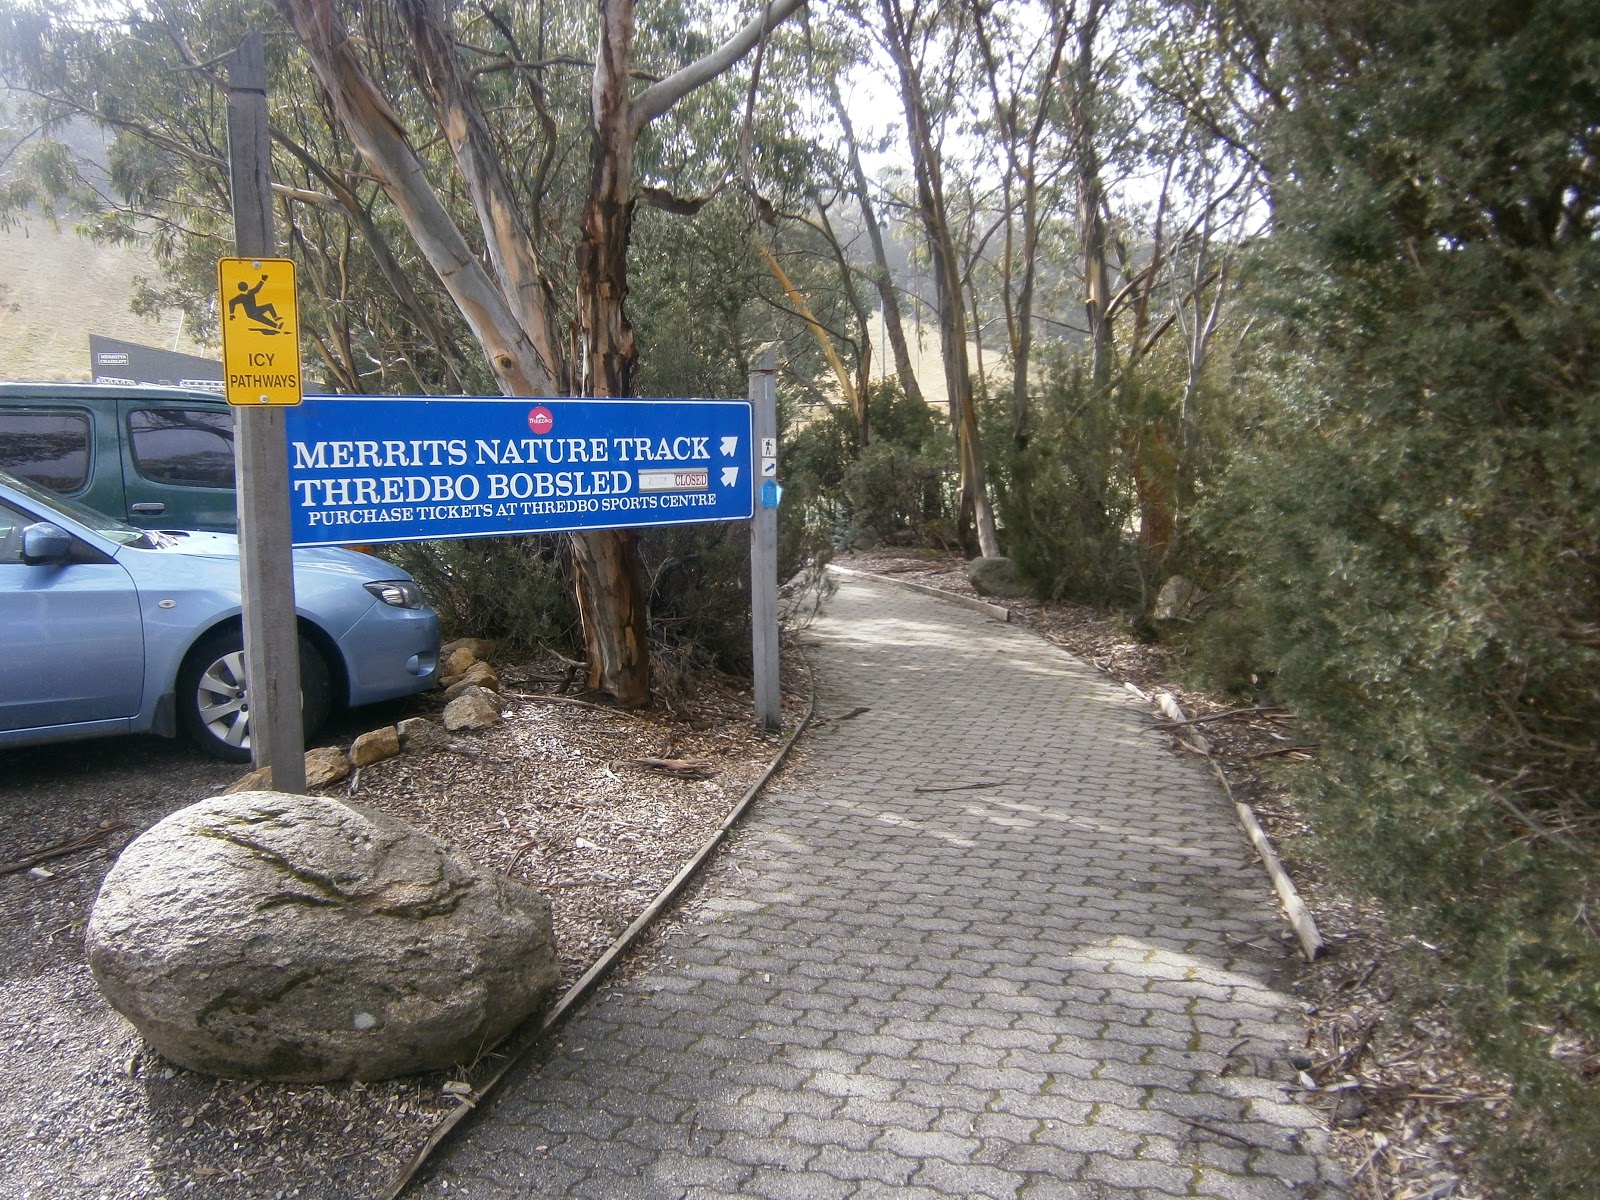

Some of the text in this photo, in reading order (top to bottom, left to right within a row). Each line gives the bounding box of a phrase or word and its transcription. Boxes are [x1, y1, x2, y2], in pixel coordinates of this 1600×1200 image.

[249, 353, 275, 367] ICY
[230, 374, 297, 388] PATHWAYS
[292, 436, 711, 469] MERRITS NATURE TRACK
[294, 471, 632, 506] THREDBO BOBSLED
[674, 474, 707, 486] CLOSED
[308, 493, 717, 526] PURCHASE TICKETS AT THREDBO SPORTS CENTRE
